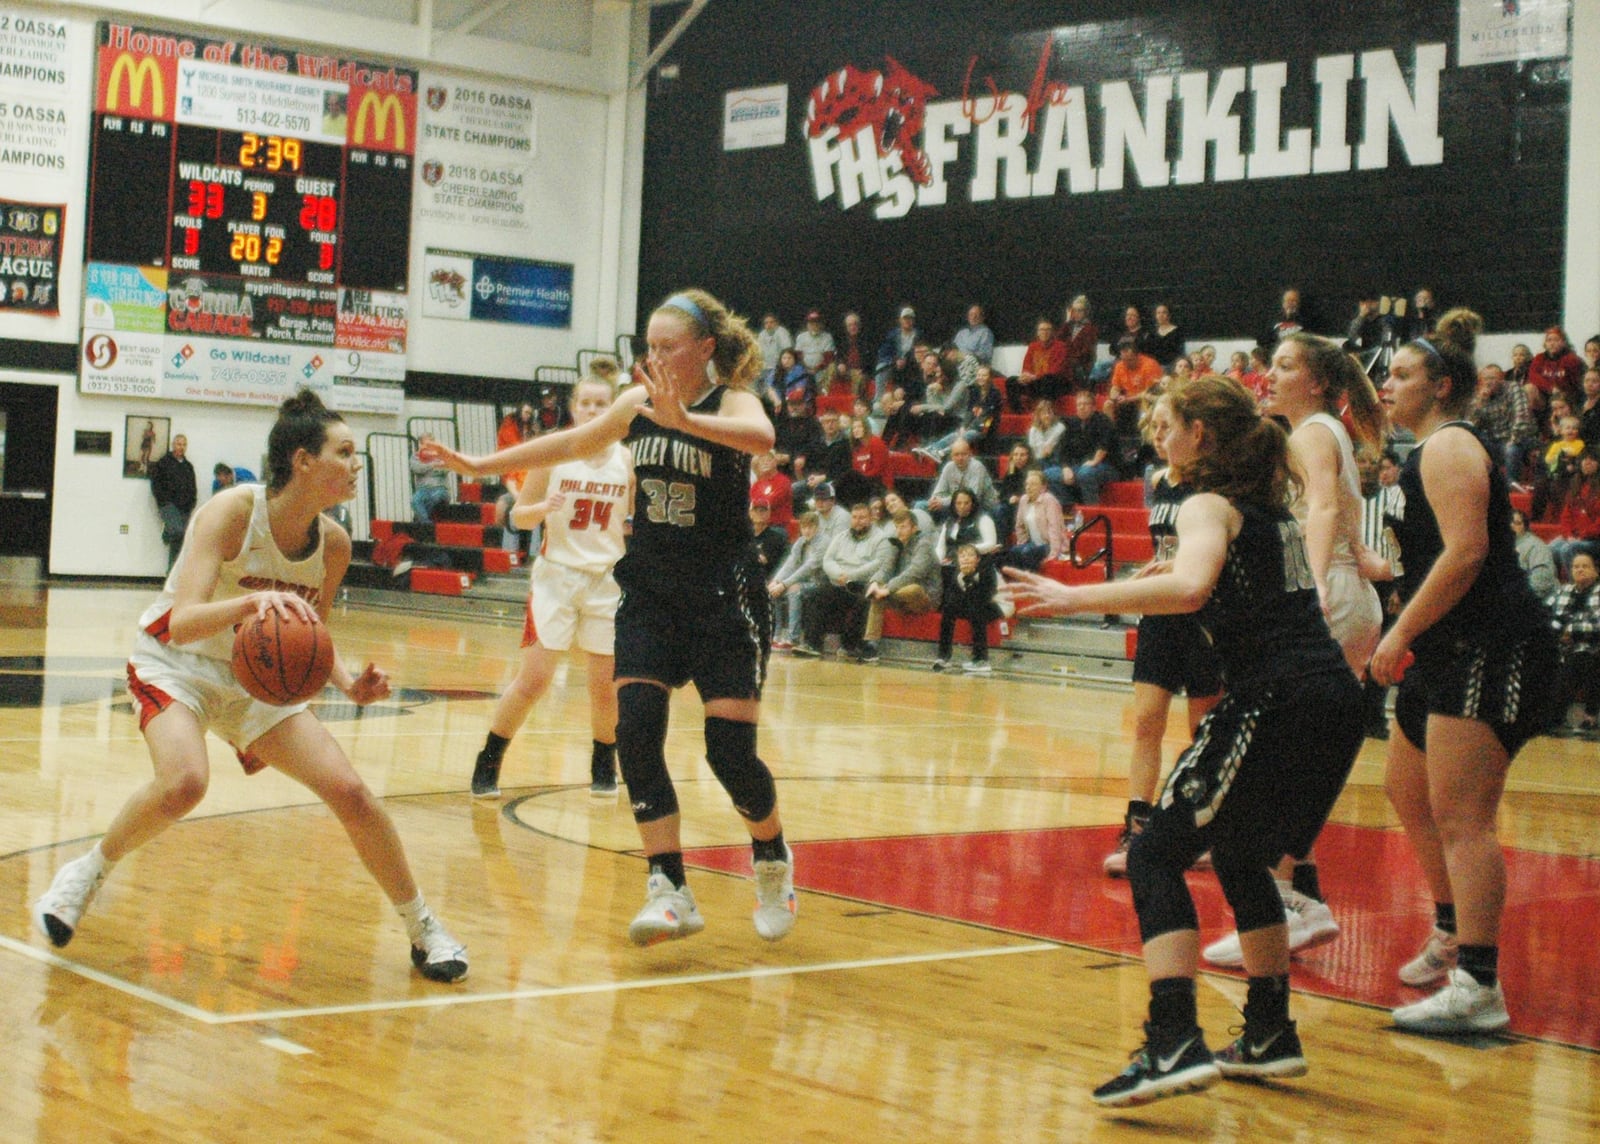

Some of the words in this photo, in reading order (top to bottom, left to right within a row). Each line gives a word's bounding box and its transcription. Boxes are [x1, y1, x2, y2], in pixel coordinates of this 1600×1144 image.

[15, 18, 67, 39] OASSA
[109, 25, 195, 58] Home
[203, 42, 235, 65] of
[241, 46, 288, 74] the
[297, 54, 412, 92] Wildcats
[454, 87, 486, 105] 2016
[489, 93, 532, 111] OASSA
[12, 104, 66, 124] OASSA
[237, 107, 311, 131] 513-422-5570
[917, 42, 1447, 208] FRANKLIN
[152, 123, 166, 137] PTS
[425, 124, 461, 141] STATE
[464, 129, 532, 152] CHAMPIONS
[239, 132, 301, 172] 2:39
[179, 163, 243, 186] WILDCATS
[448, 164, 477, 179] 2018
[480, 168, 524, 186] OASSA
[809, 122, 917, 220] FHS
[244, 180, 274, 194] PERIOD
[296, 178, 336, 197] GUEST
[187, 180, 225, 220] 33
[252, 192, 267, 221] 3
[434, 193, 465, 207] STATE
[467, 198, 525, 215] CHAMPIONS
[174, 215, 202, 229] FOULS
[299, 194, 337, 233] 28
[228, 223, 261, 236] PLAYER
[265, 227, 286, 240] FOUL
[310, 230, 337, 244] FOULS
[230, 233, 262, 263] 20
[265, 237, 283, 266] 2
[0, 256, 54, 279] AGUE
[172, 257, 201, 271] SCORE
[241, 264, 271, 277] MATCH
[307, 271, 335, 285] SCORE
[496, 283, 534, 297] Premier
[537, 288, 570, 302] Health
[295, 329, 334, 343] Basement
[209, 348, 228, 361] Go
[231, 350, 292, 366] Wildcats!
[672, 439, 713, 478] VIEW
[560, 479, 626, 497] WILDCATS
[641, 478, 696, 527] 32
[569, 498, 614, 532] 34
